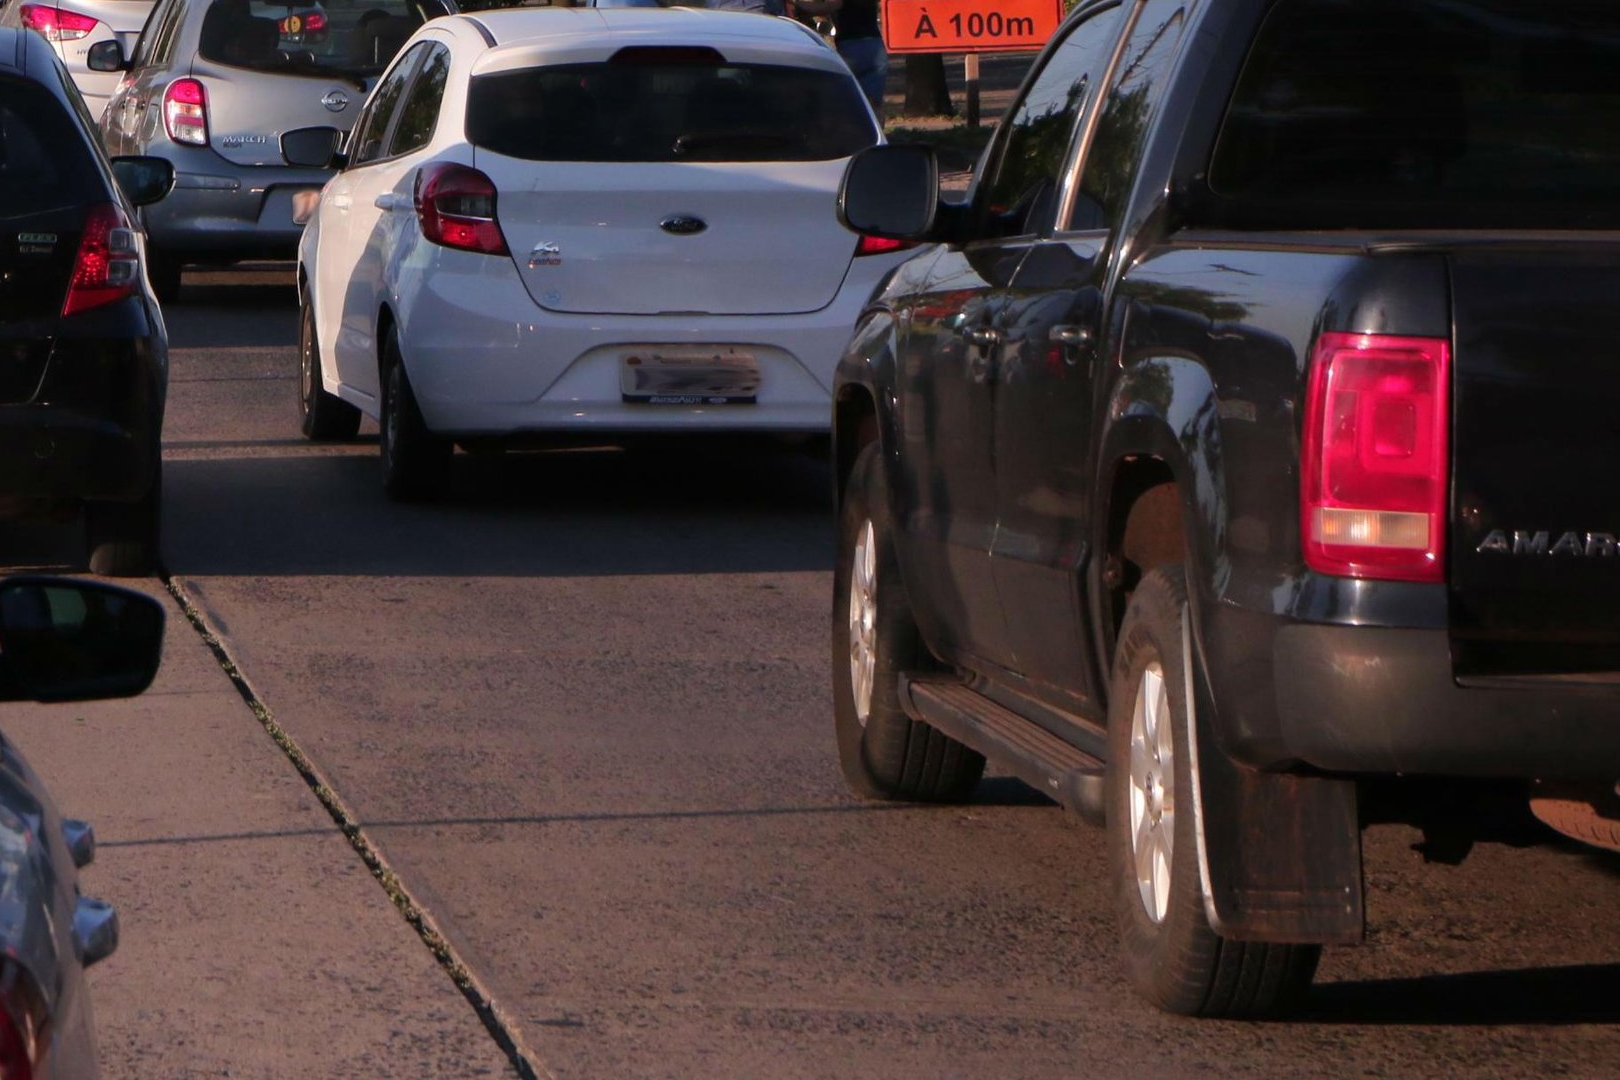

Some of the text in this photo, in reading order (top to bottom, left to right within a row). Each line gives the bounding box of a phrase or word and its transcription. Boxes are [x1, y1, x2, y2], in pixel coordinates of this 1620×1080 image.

[914, 7, 1034, 39] À 100m
[1476, 529, 1620, 556] AMAR
